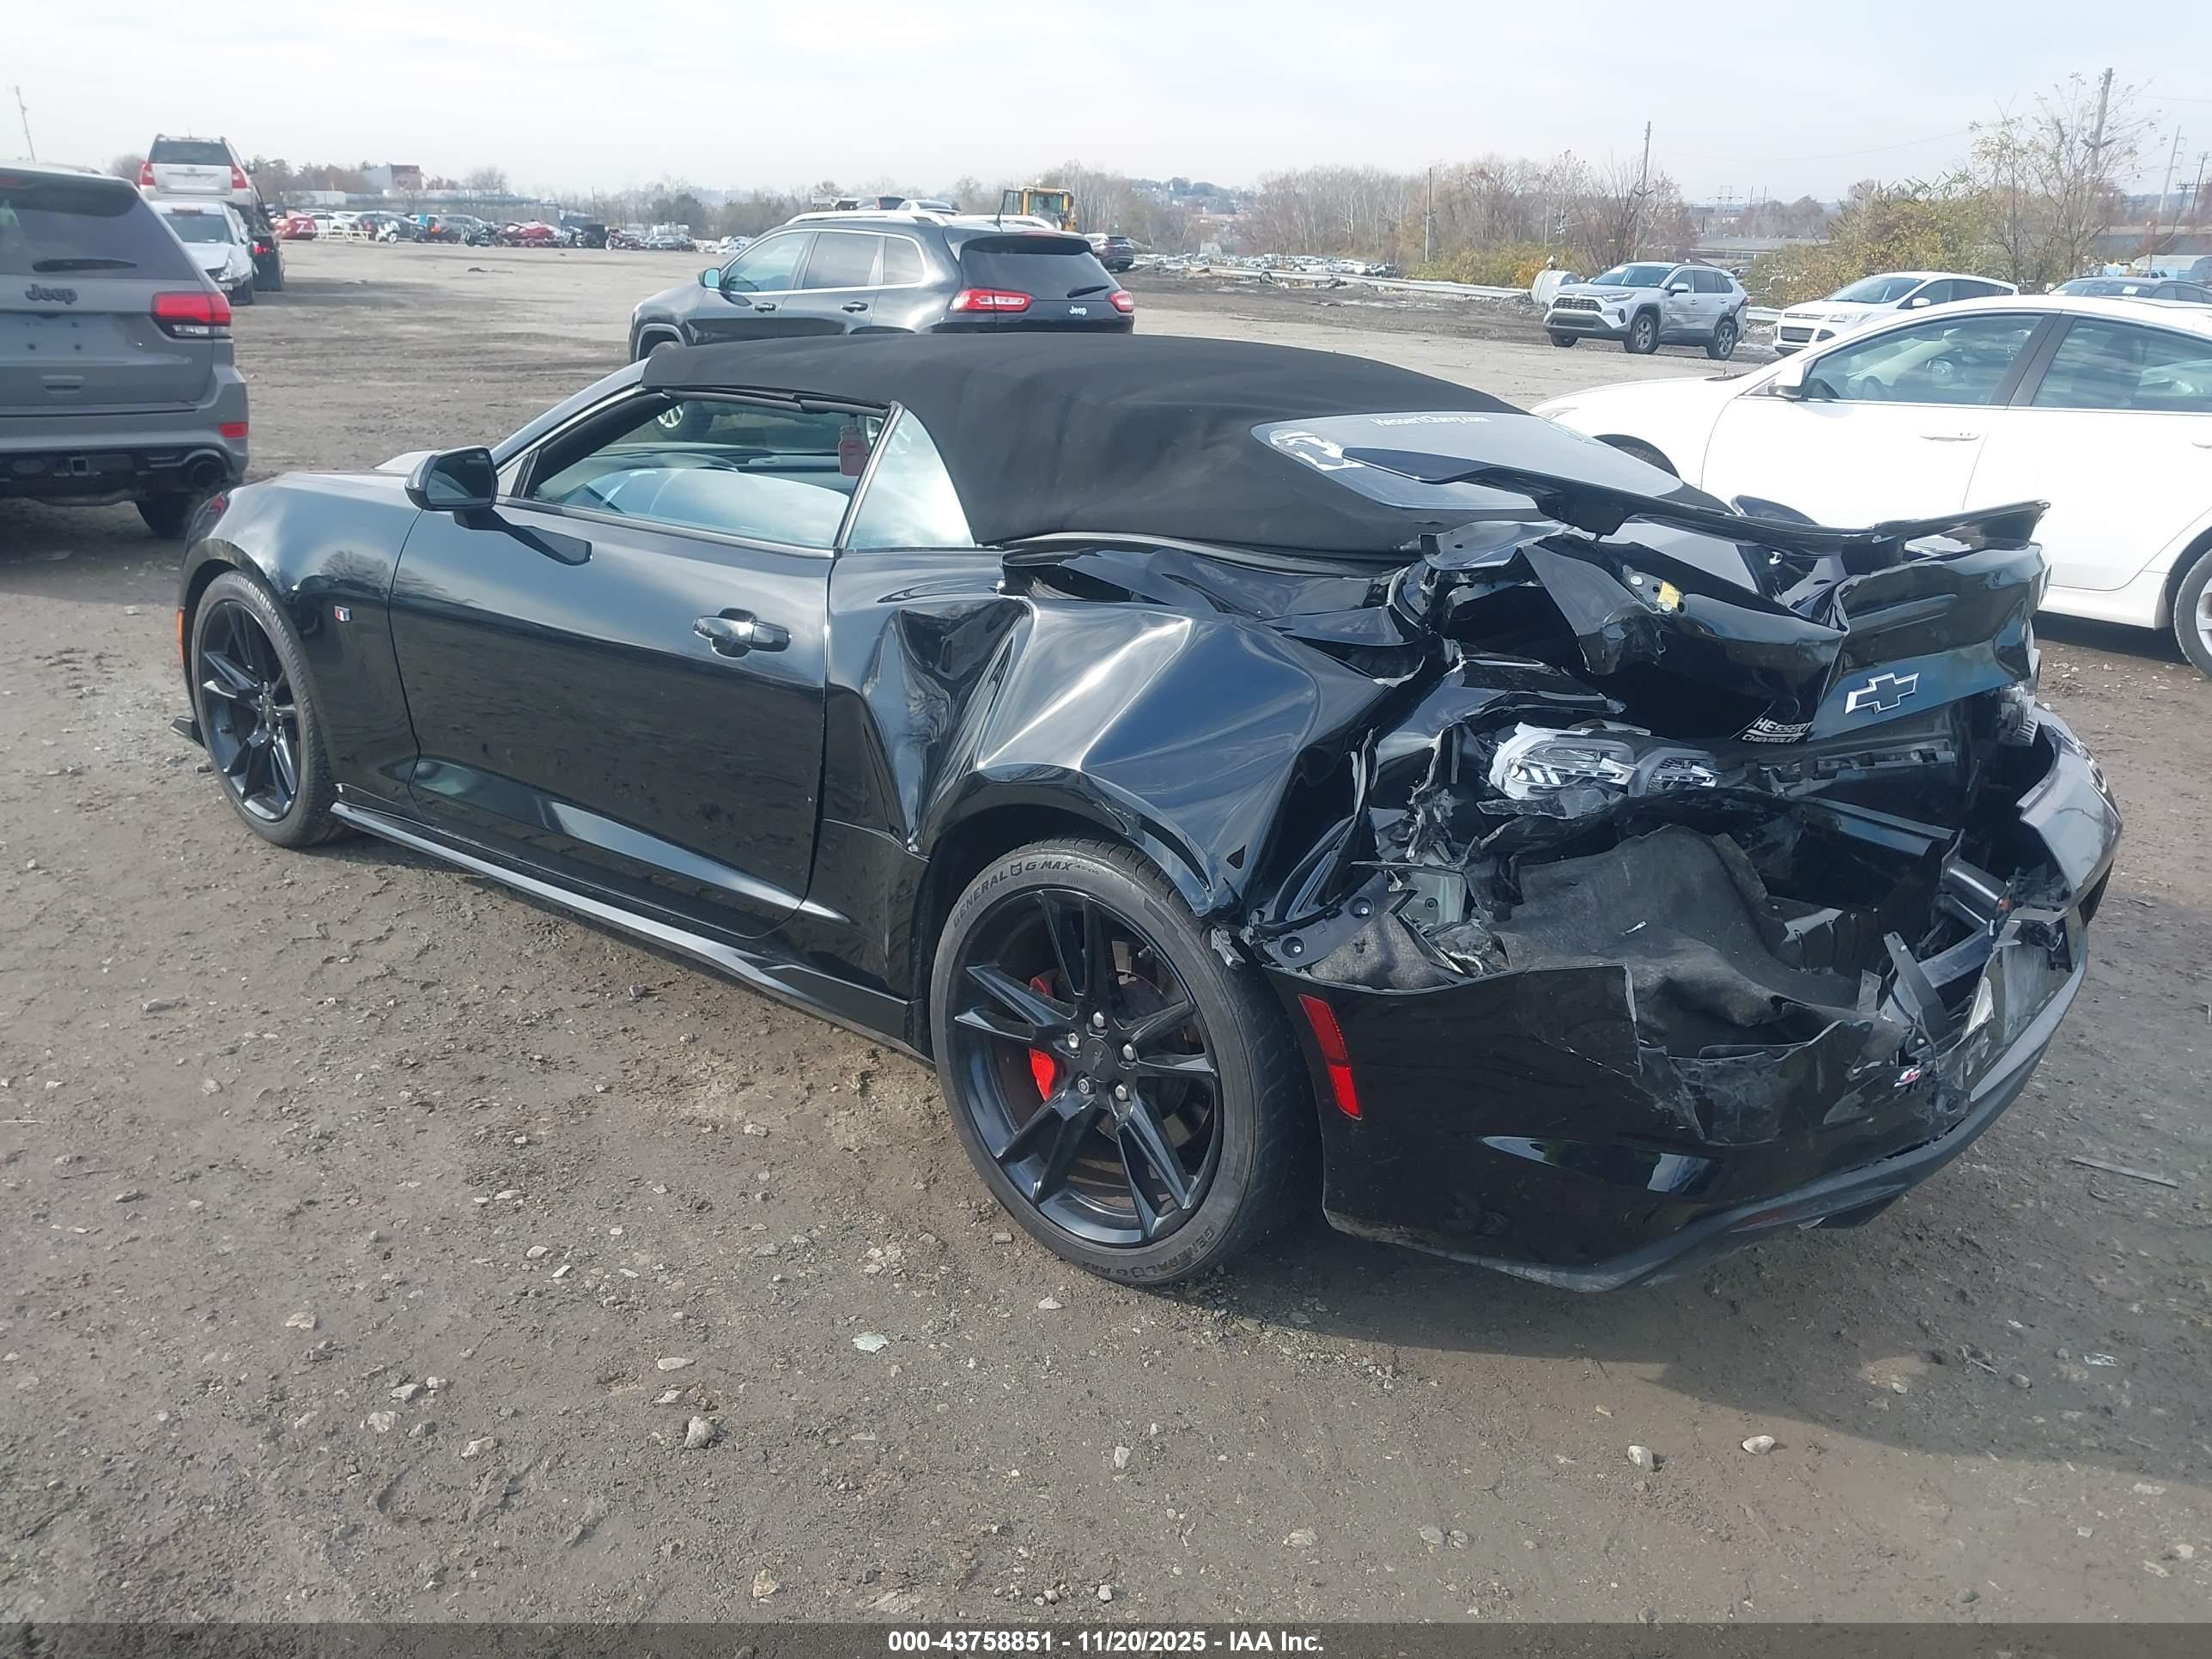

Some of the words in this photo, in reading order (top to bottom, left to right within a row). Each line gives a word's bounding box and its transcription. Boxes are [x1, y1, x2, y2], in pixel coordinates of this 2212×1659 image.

[25, 284, 77, 305] Jeep
[1069, 306, 1087, 316] Jeep
[1753, 718, 1814, 733] HESSERT
[1741, 734, 1800, 743] CHEVROLET
[953, 870, 1008, 928] GENERAL
